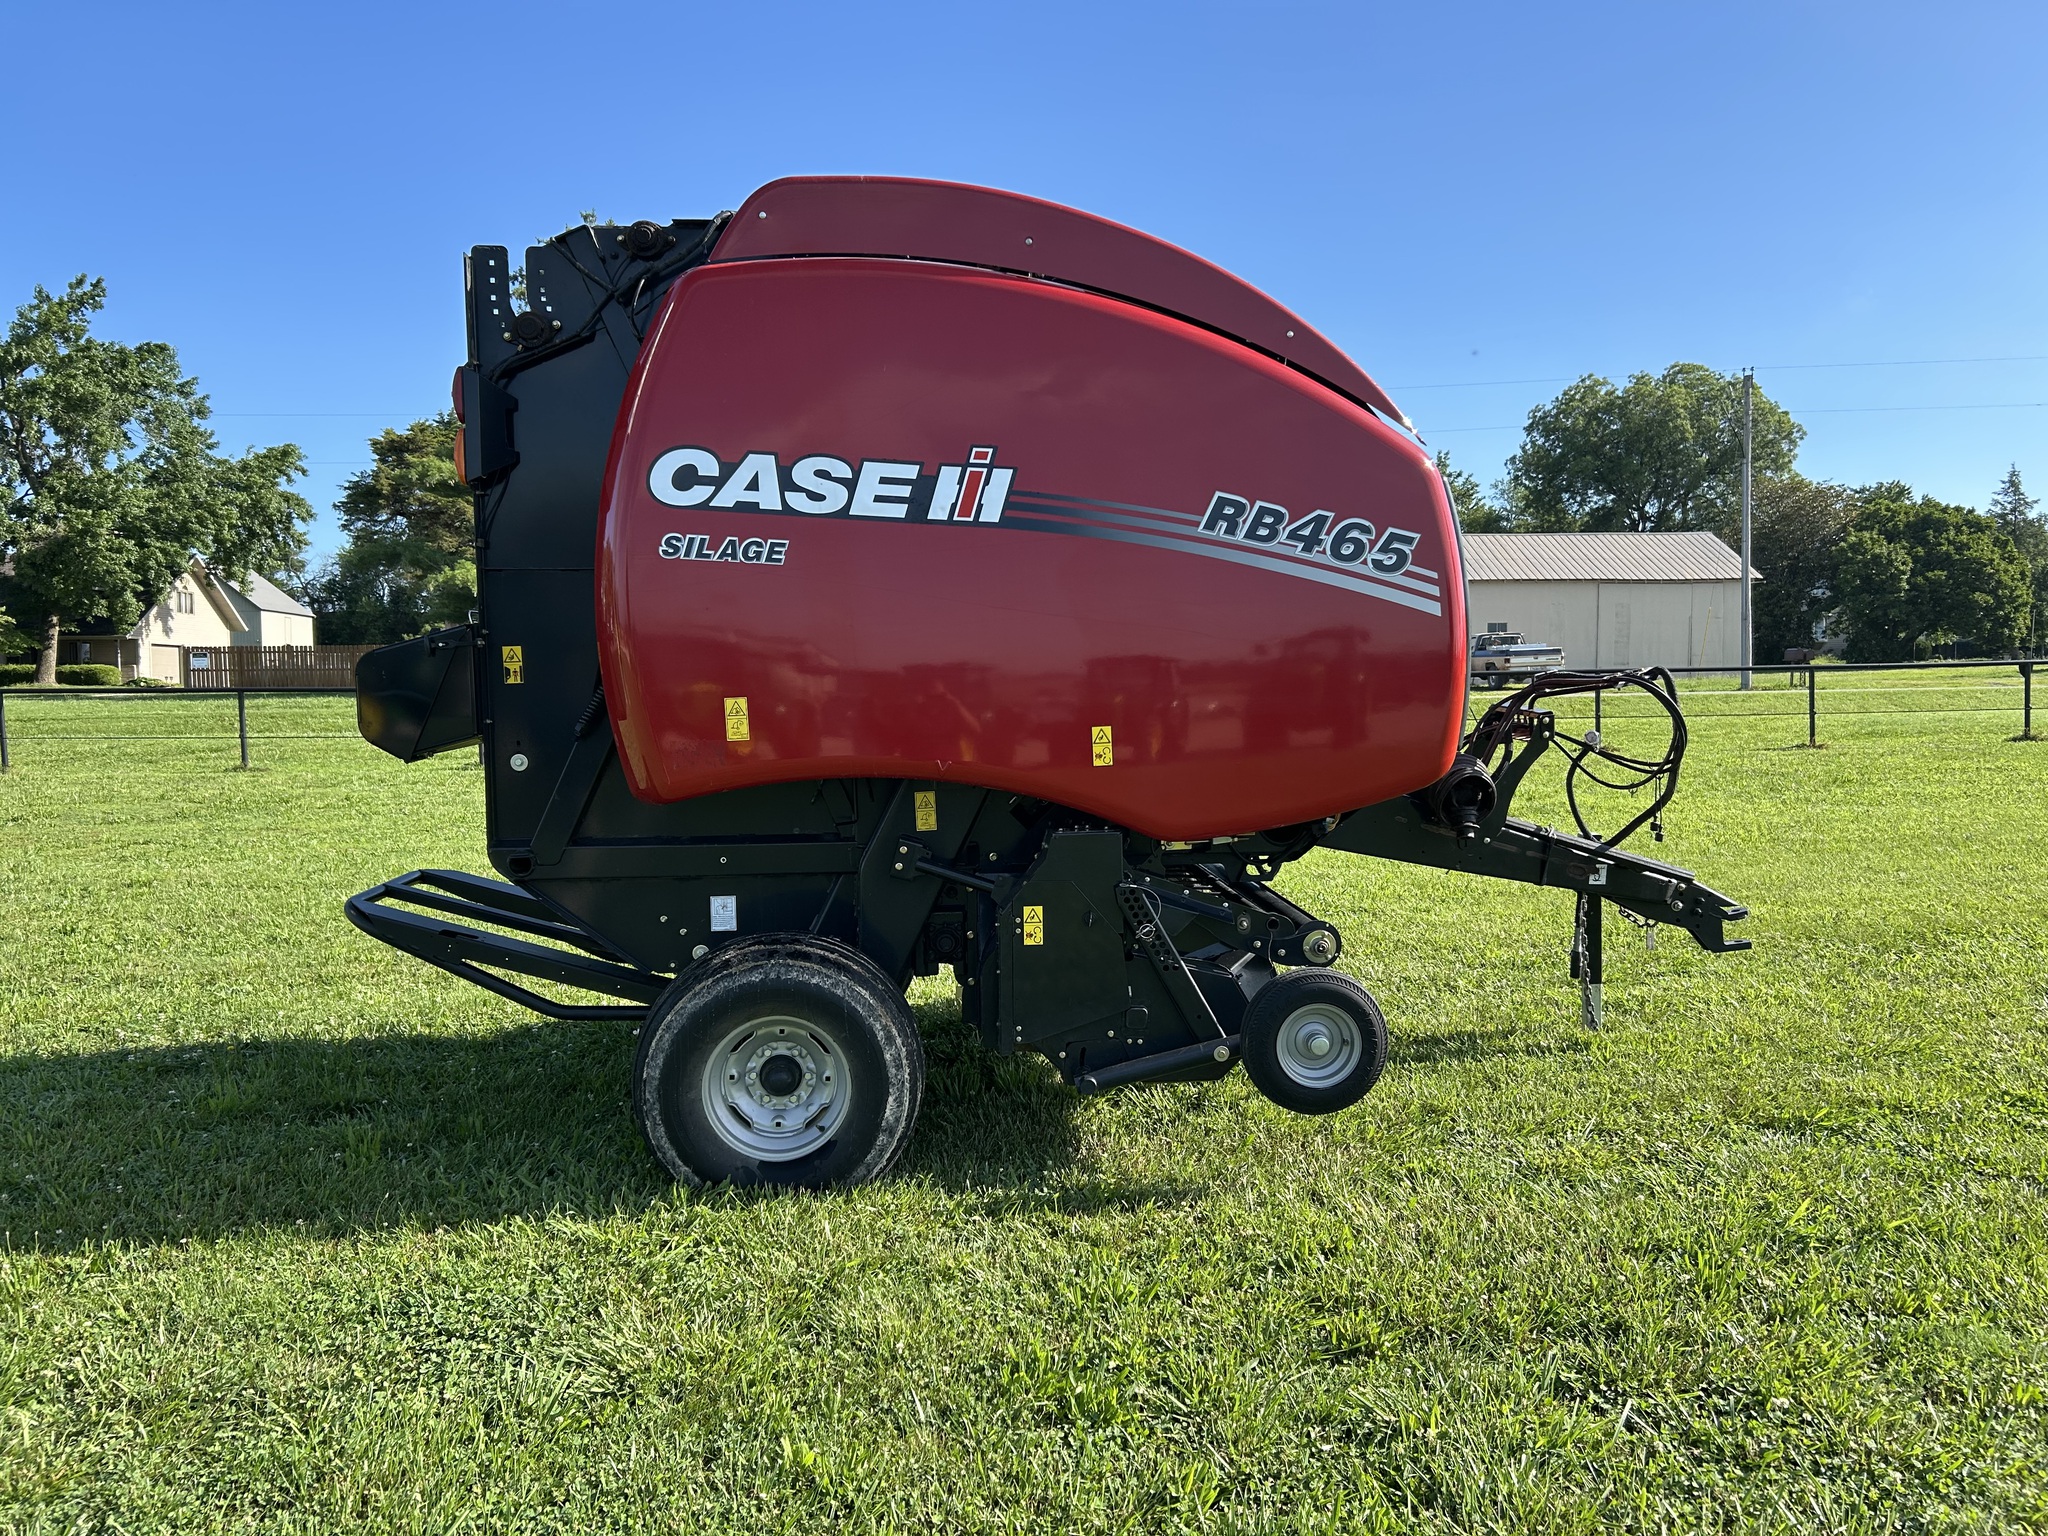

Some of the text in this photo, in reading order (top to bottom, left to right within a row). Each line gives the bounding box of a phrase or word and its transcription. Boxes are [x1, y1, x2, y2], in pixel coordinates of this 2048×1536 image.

[650, 448, 920, 518] CASE
[659, 533, 789, 565] SILAGE
[1198, 491, 1421, 576] RB465
